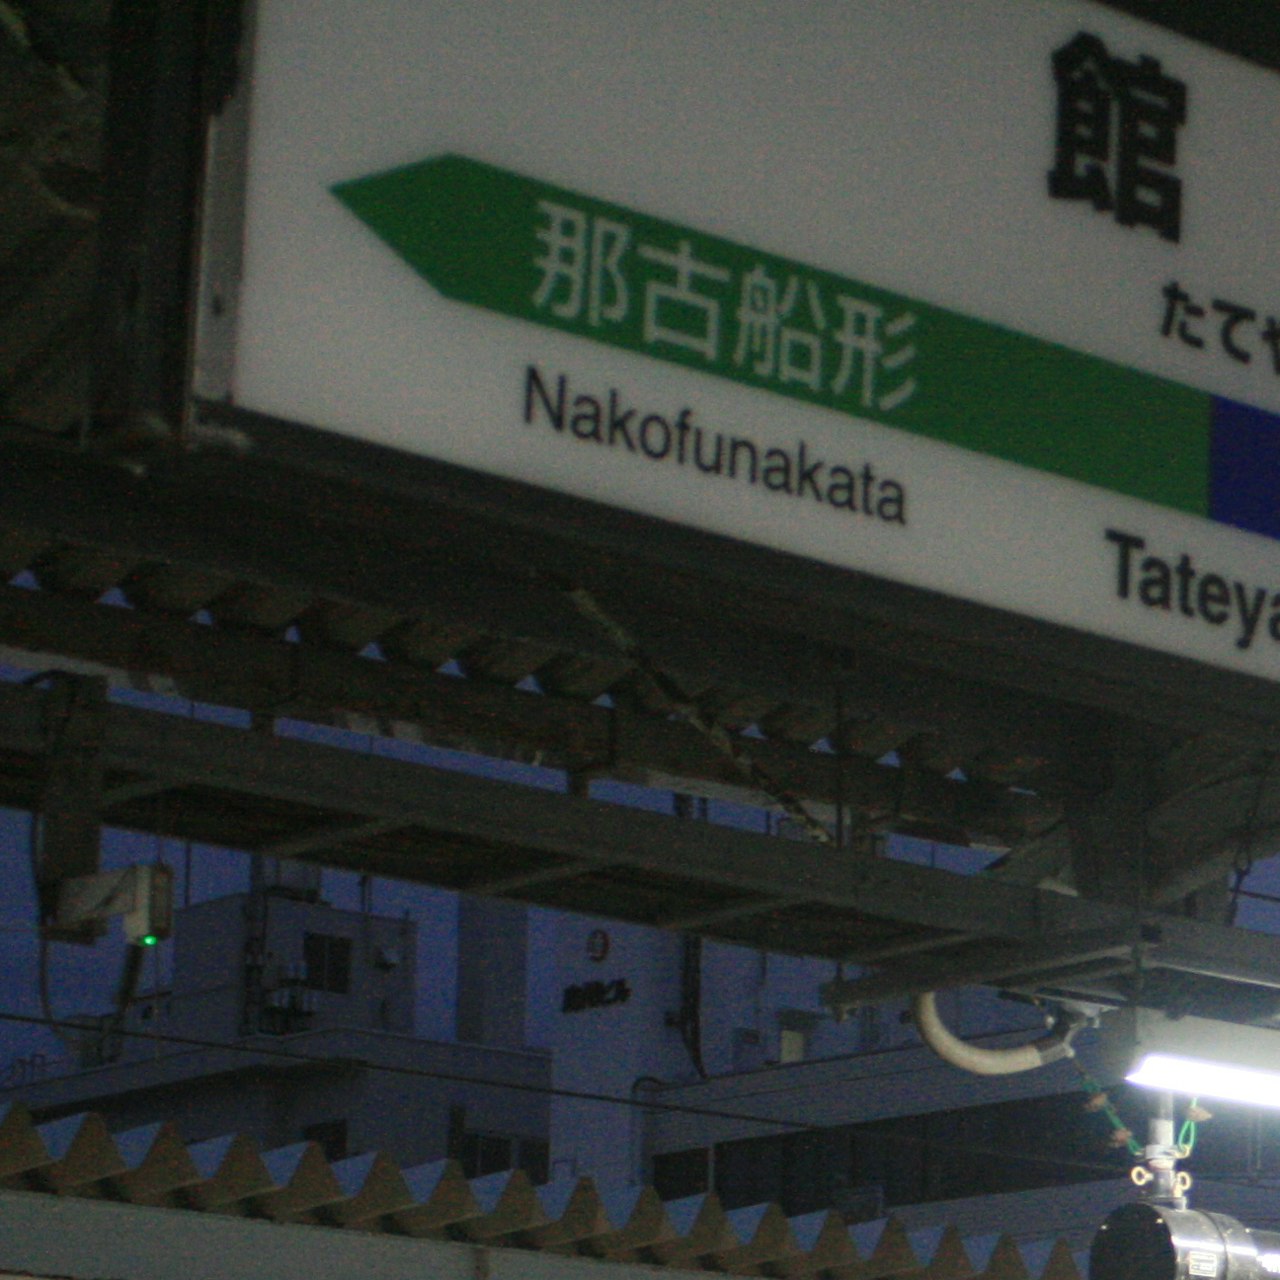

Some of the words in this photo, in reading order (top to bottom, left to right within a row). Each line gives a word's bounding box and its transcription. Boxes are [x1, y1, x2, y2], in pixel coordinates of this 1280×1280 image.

[532, 199, 918, 412] 那古船形
[522, 364, 908, 527] Nakofunakata
